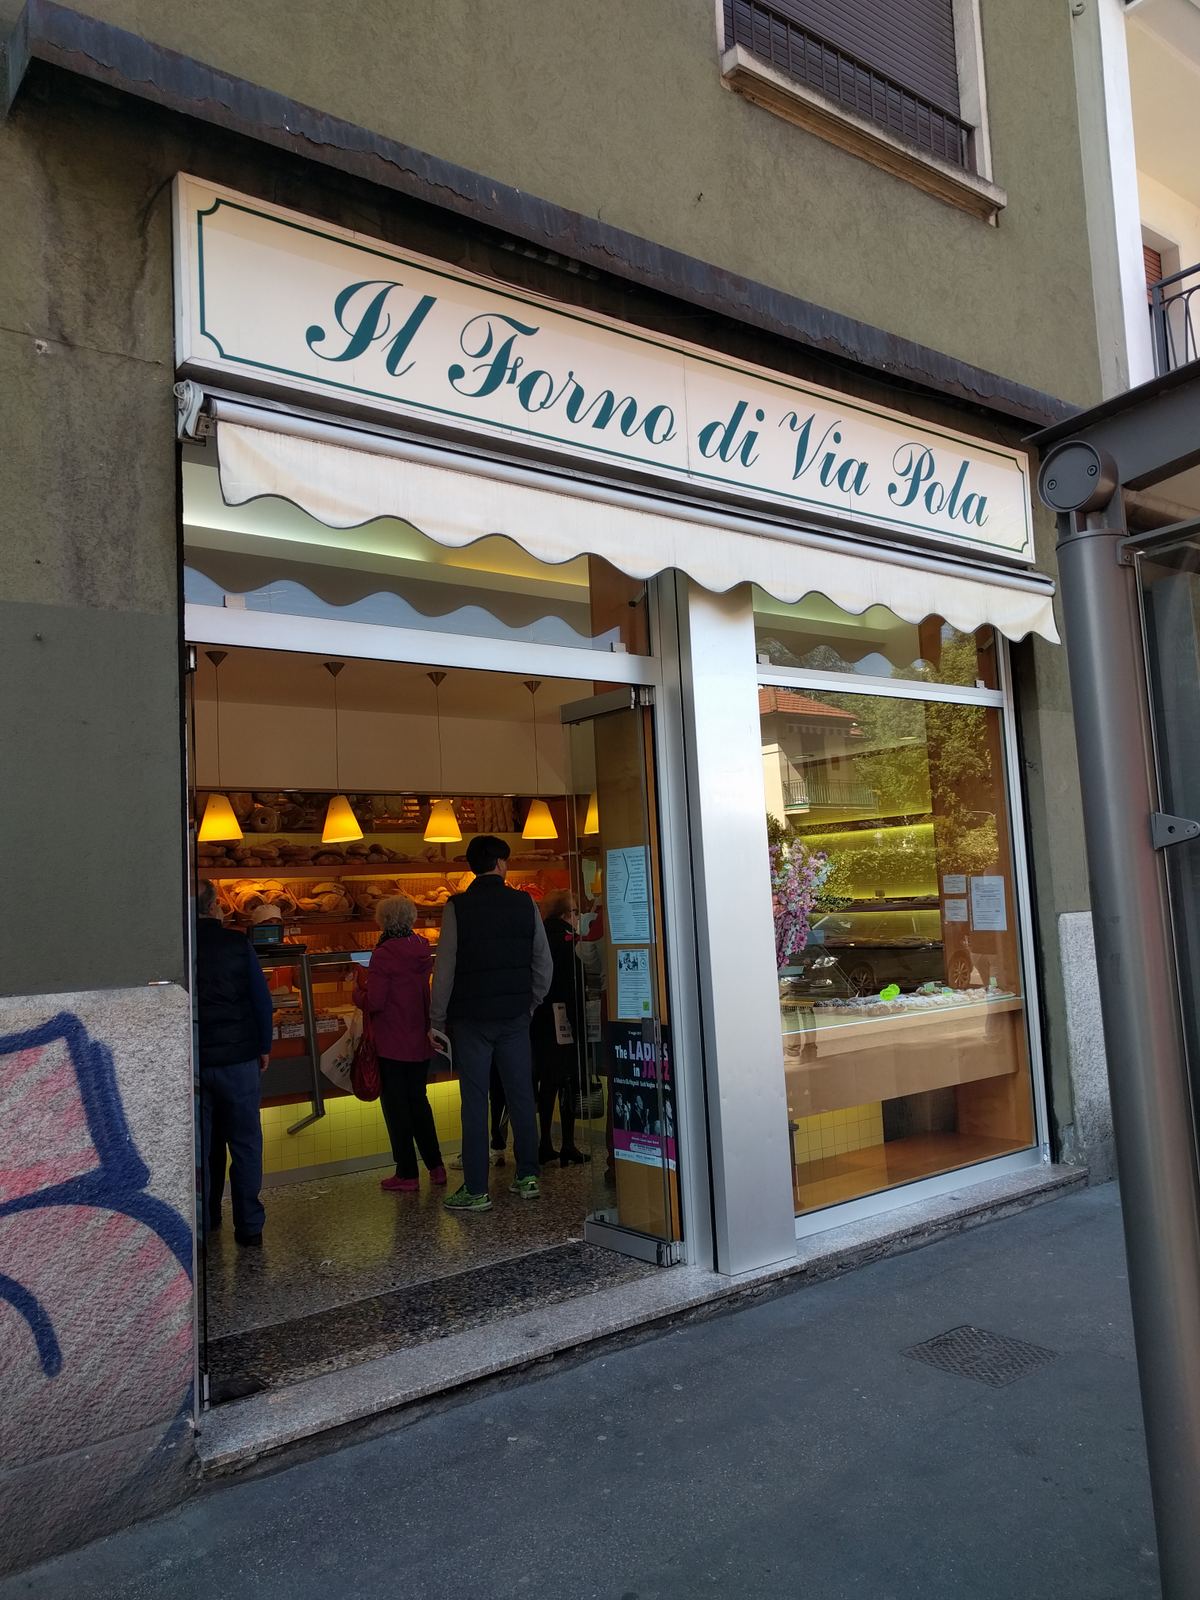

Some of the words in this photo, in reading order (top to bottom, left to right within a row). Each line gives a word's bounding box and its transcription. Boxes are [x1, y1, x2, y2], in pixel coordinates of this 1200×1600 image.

[305, 280, 437, 377] Il
[448, 313, 678, 445] Forno
[697, 400, 765, 468] di
[778, 411, 870, 496] Via
[887, 442, 990, 528] Pola
[614, 1044, 628, 1060] The
[633, 1063, 641, 1078] in
[641, 1059, 671, 1081] JAZ
